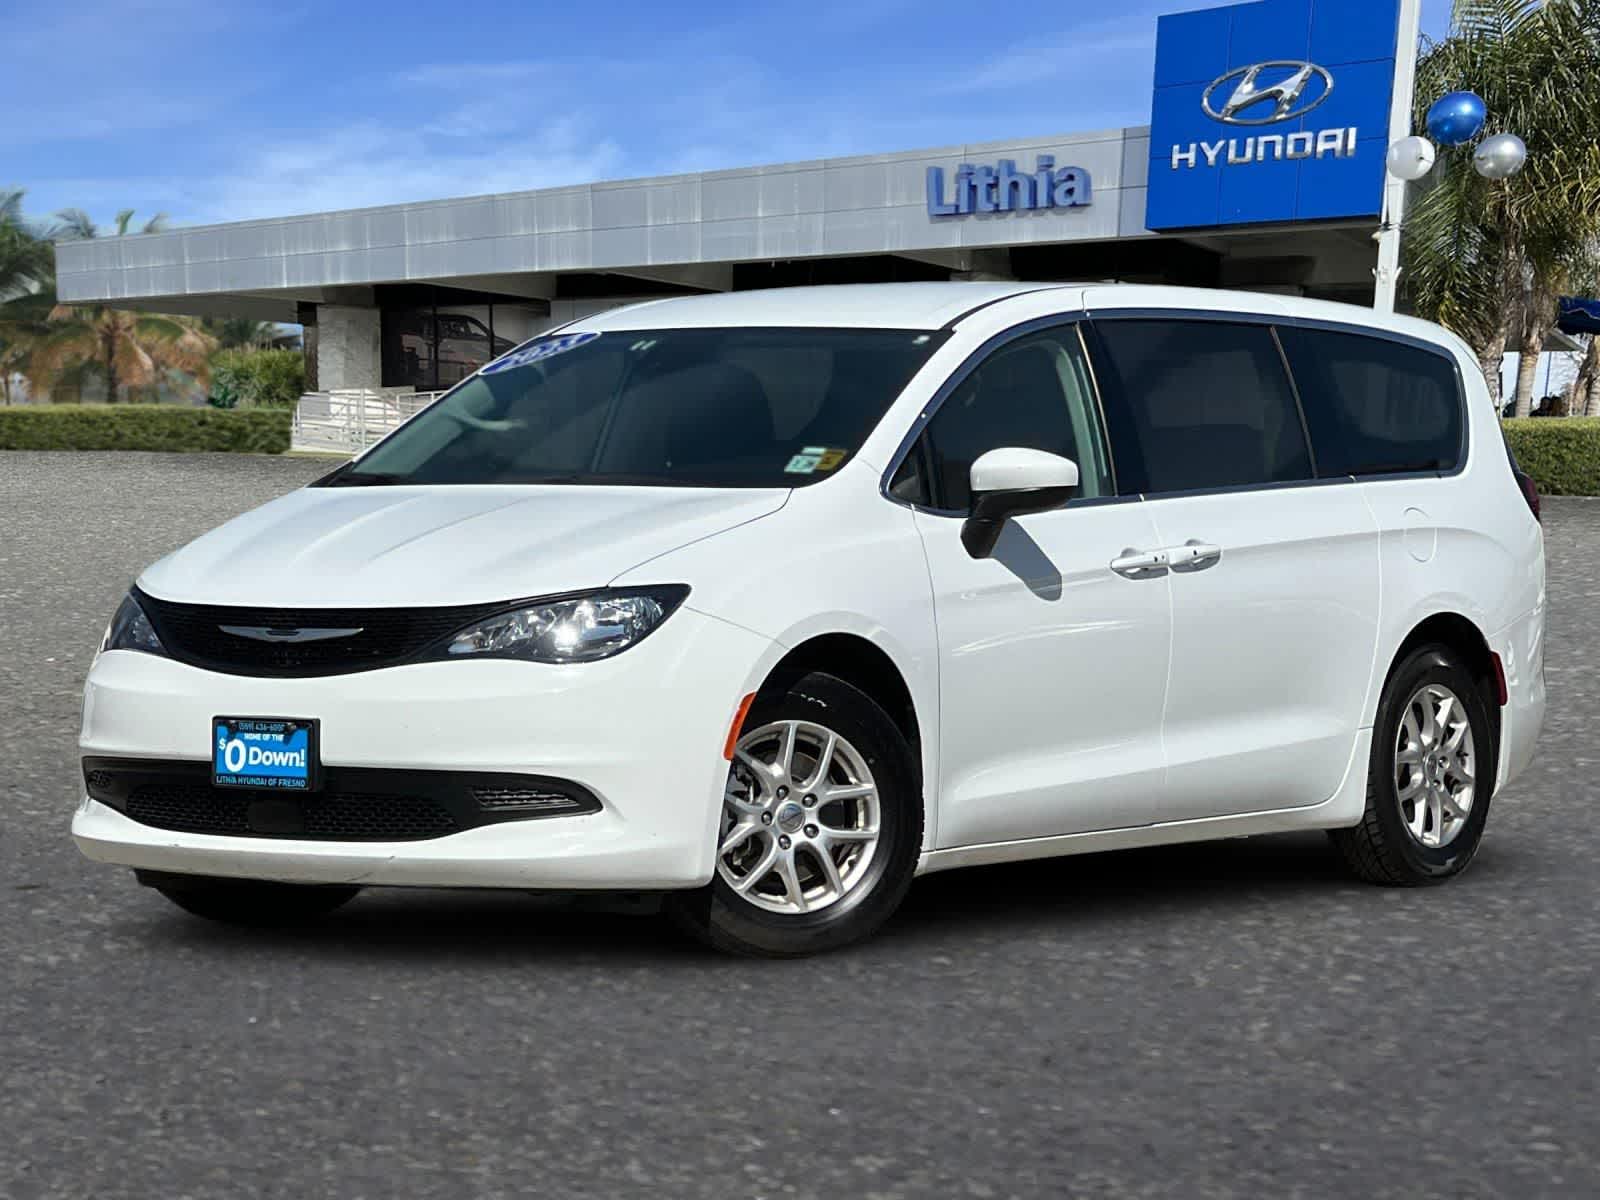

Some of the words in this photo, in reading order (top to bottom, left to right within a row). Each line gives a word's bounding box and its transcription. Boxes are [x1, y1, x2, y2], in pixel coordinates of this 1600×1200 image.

[1171, 127, 1358, 169] HYUNDAI
[926, 154, 1092, 216] Lithia
[248, 746, 305, 767] Down!
[216, 776, 237, 784] LITHIA
[238, 776, 267, 785] HYUNDAI
[267, 778, 277, 786] OF
[278, 779, 306, 787] FRESNO
